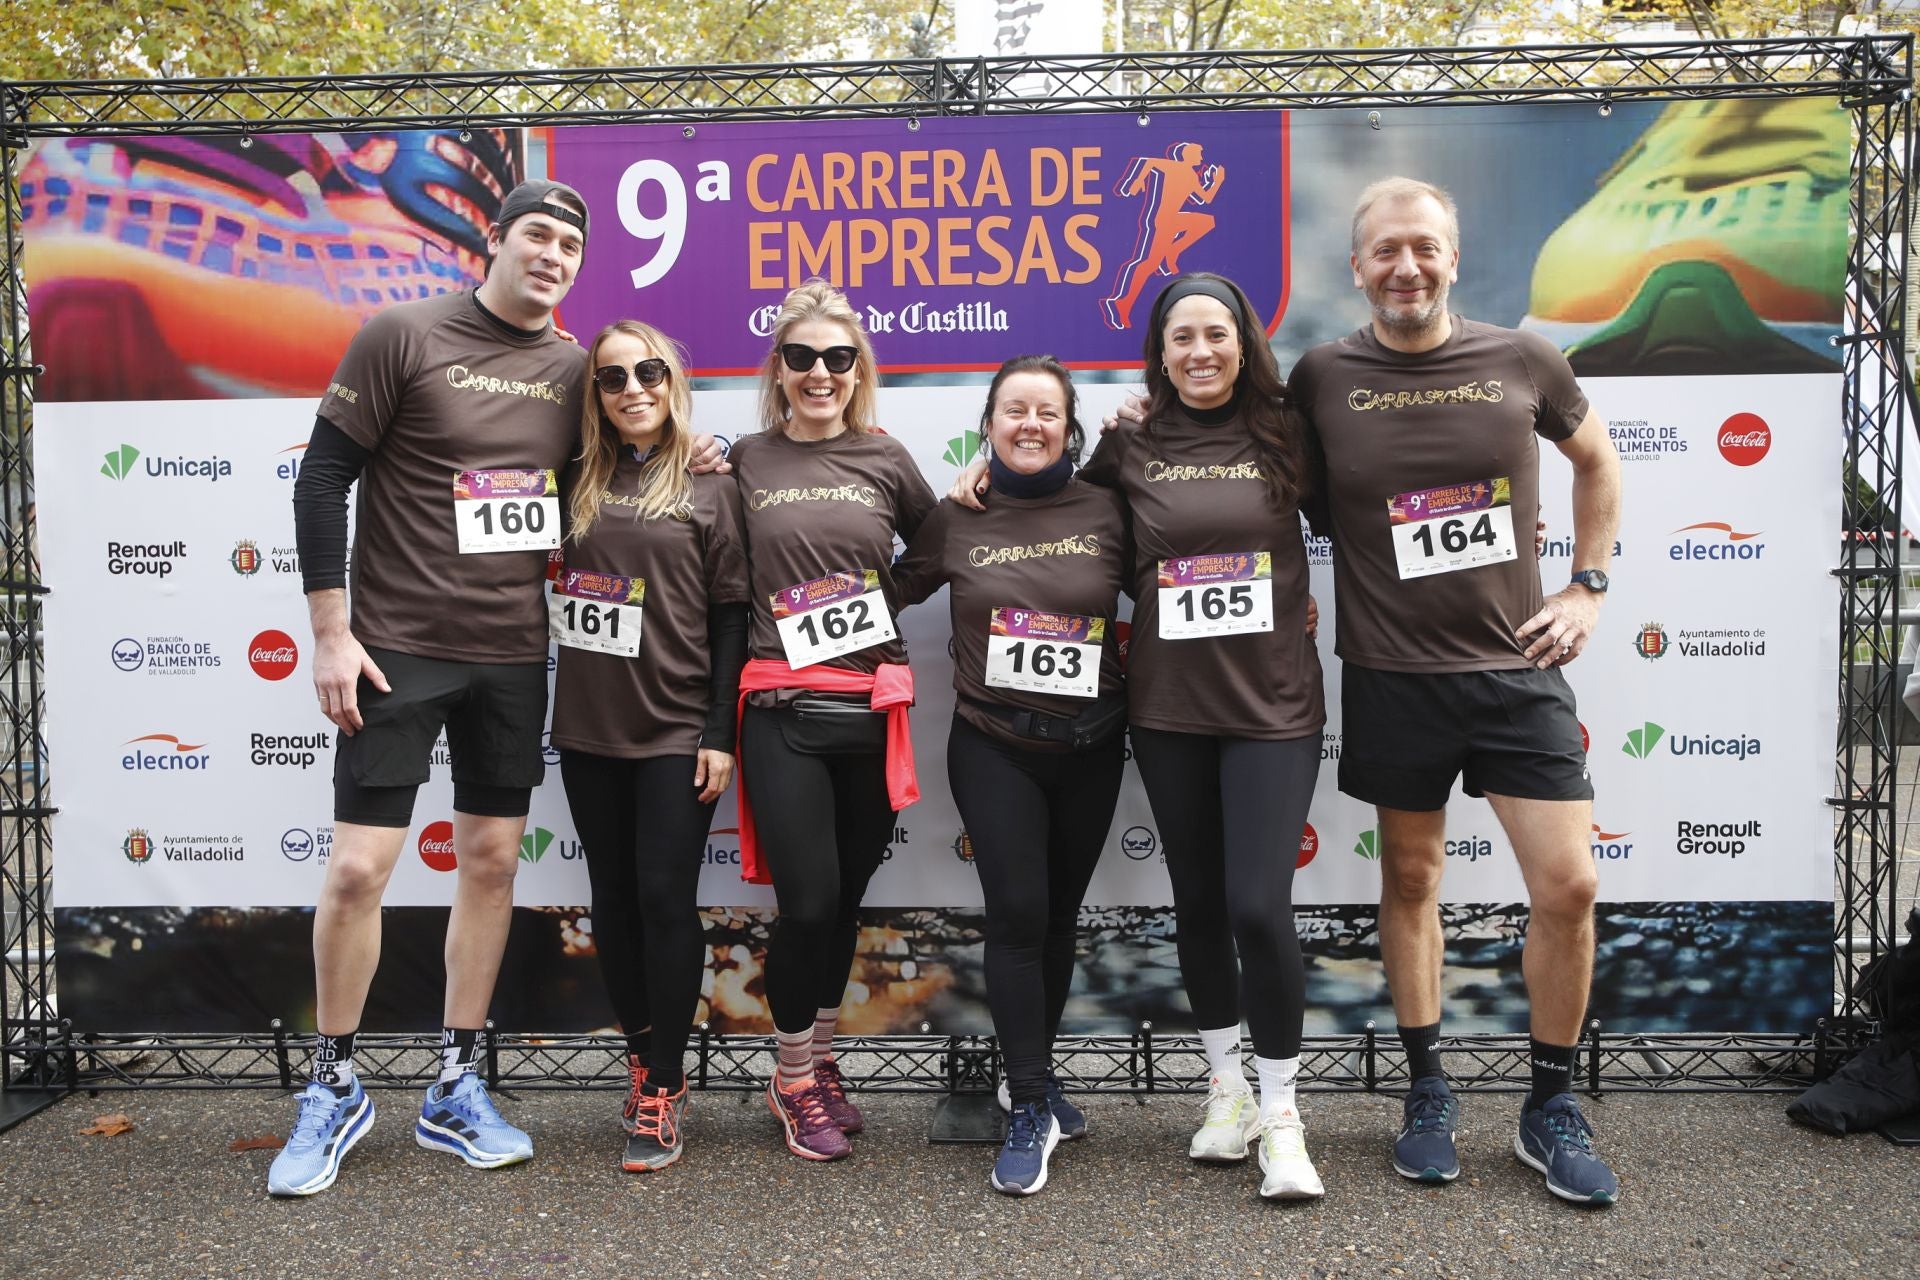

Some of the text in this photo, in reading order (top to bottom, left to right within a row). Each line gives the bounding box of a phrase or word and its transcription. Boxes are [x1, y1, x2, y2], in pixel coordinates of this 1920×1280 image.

[746, 148, 1012, 213] CARRERA
[1030, 146, 1103, 207] DE
[748, 213, 1102, 290] EMPRESAS
[866, 304, 896, 334] de
[899, 301, 1010, 334] Castilla
[1609, 427, 1677, 439] BANCO DE
[1720, 430, 1768, 448] Coca-Cola
[145, 456, 232, 482] Unicaja
[490, 472, 519, 480] CARRERA
[1145, 460, 1266, 483] CARRASVIÑA
[491, 479, 529, 489] EMPRESAS
[1426, 487, 1460, 500] CARRERA
[1461, 485, 1471, 493] DE
[1428, 494, 1472, 509] EMPRESAS
[474, 501, 545, 535] 160
[1412, 513, 1497, 557] 164
[108, 541, 187, 558] Renault
[1669, 539, 1765, 561] elecnor
[108, 558, 173, 578] Group
[1192, 557, 1224, 566] CARRERA
[1225, 556, 1234, 564] DE
[1193, 563, 1234, 575] EMPRESAS
[578, 580, 612, 593] EMPRESAS
[804, 577, 835, 592] CARRERA
[806, 581, 847, 600] EMPRESAS
[1176, 585, 1254, 622] 165
[563, 600, 620, 639] 161
[797, 600, 875, 647] 162
[1028, 621, 1069, 632] EMPRESAS
[1060, 615, 1070, 623] DE
[1679, 628, 1766, 639] Ayuntamiento de
[147, 643, 211, 655] BANCO DE
[251, 647, 295, 663] Coca-Cola
[1679, 641, 1765, 656] Valladolid
[148, 656, 221, 668] ALIMENTOS
[1006, 641, 1082, 679] 163
[251, 732, 330, 749] Renault
[1670, 734, 1761, 761] Unicaja
[122, 750, 210, 770] elecnor
[251, 749, 316, 769] Group
[1677, 820, 1762, 838] Renault
[163, 835, 243, 845] Ayuntamiento de
[1444, 835, 1492, 862] caja
[1677, 838, 1746, 858] Group
[165, 847, 244, 861] Valladolid
